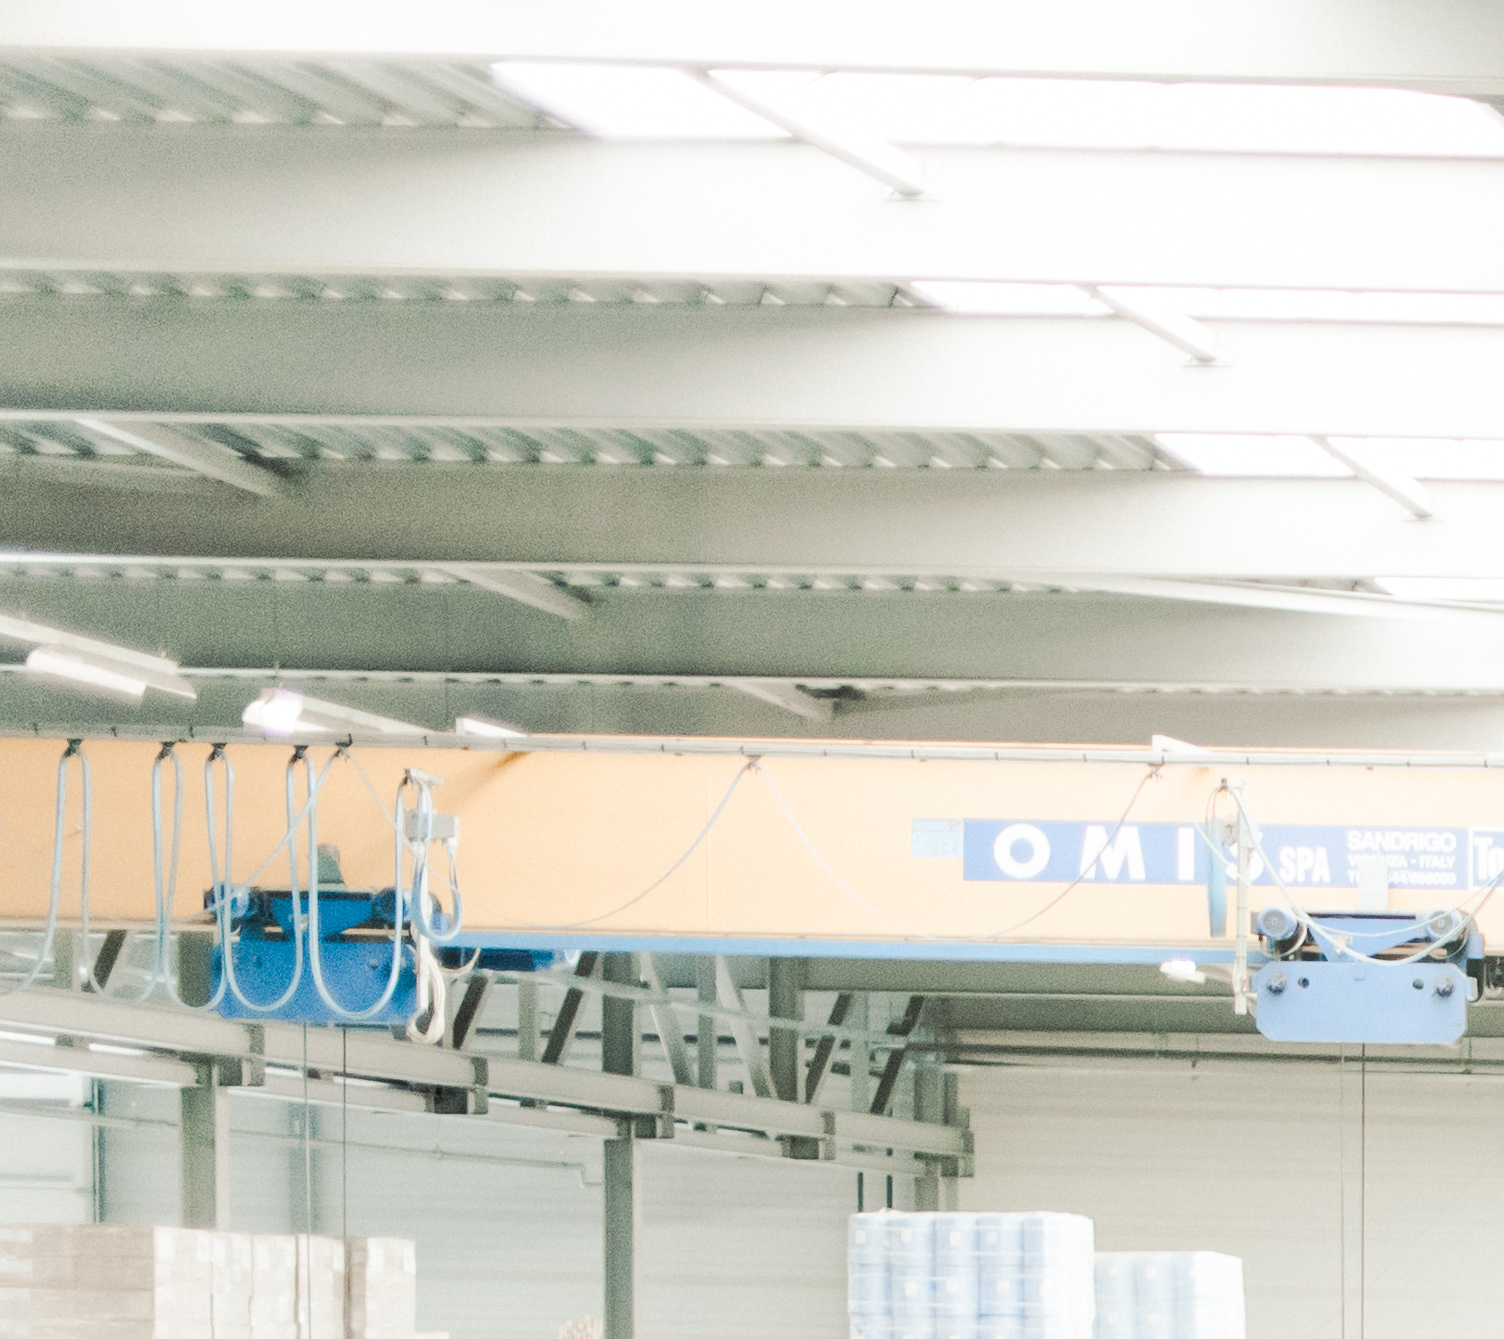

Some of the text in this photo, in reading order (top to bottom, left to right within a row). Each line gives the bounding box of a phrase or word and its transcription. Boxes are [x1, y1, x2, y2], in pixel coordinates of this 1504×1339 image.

[1347, 830, 1457, 852] SANDRIGO
[1279, 844, 1332, 885] SPA
[1419, 854, 1456, 869] ITALY
